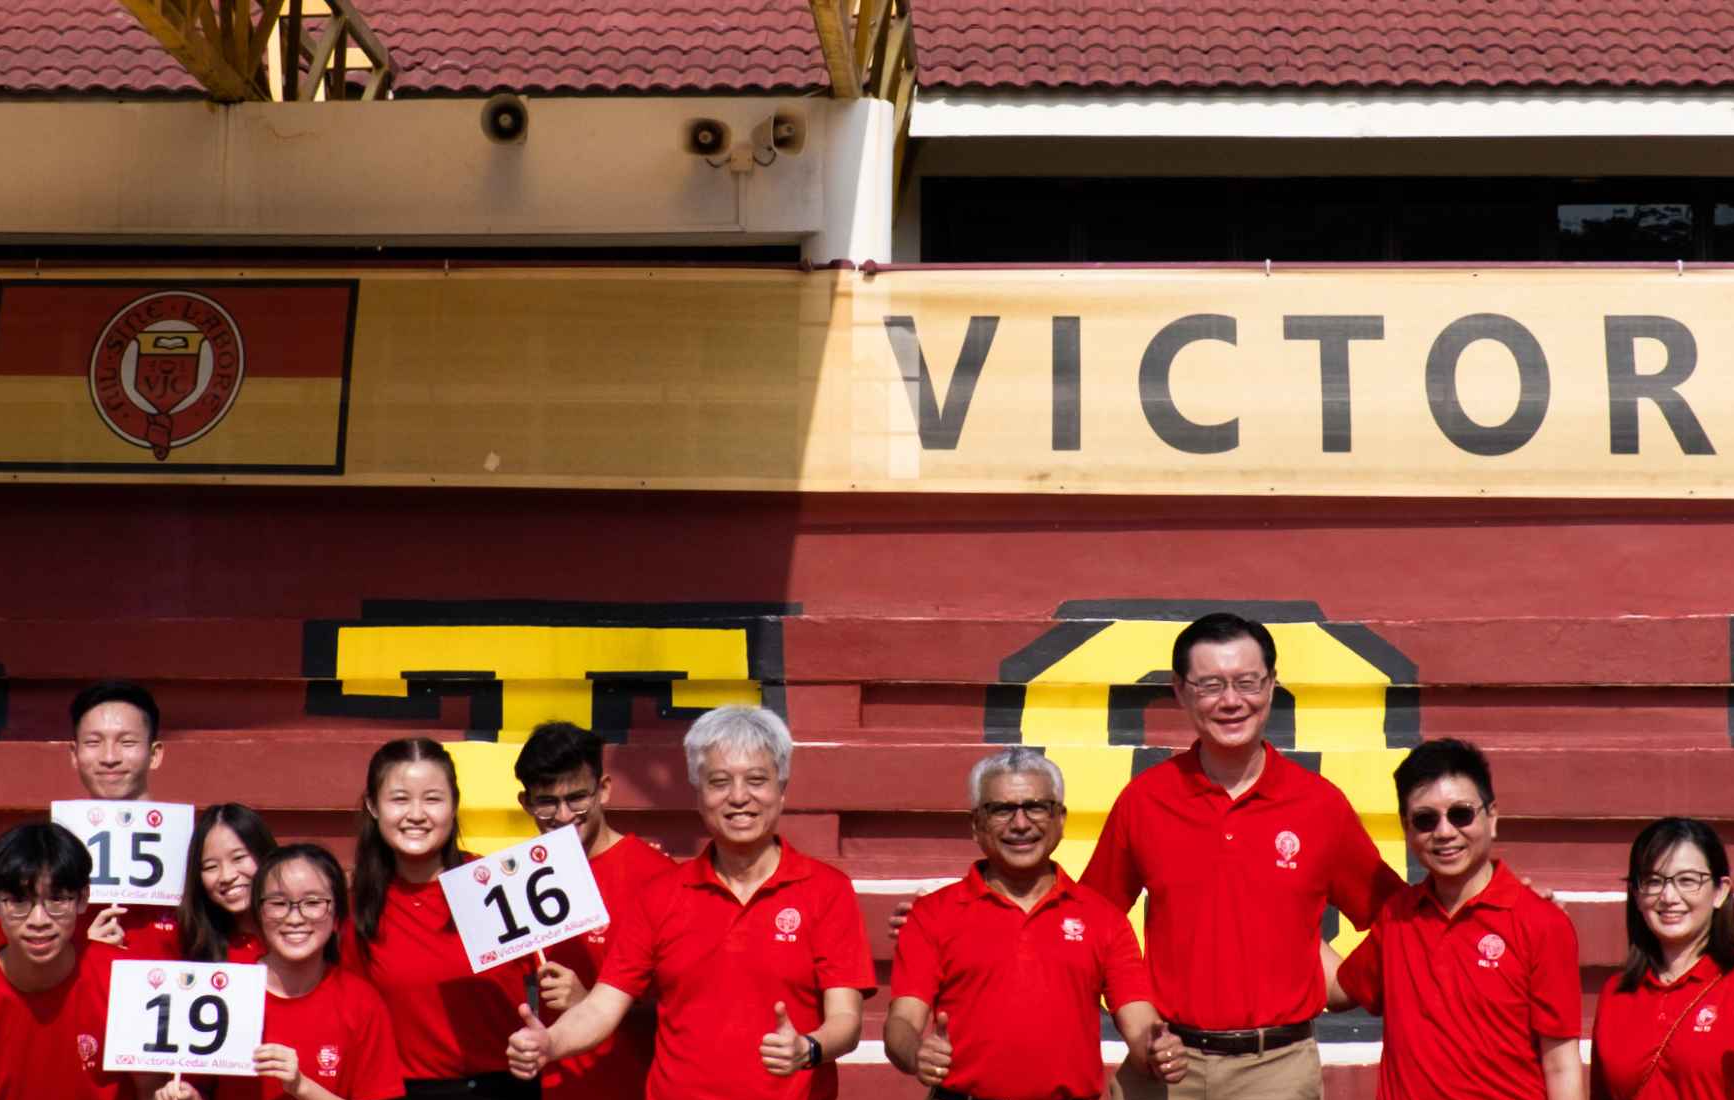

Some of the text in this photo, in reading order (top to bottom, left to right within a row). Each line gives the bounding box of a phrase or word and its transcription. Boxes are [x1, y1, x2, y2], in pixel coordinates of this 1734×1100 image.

[87, 830, 164, 888] 15
[484, 866, 570, 945] 16
[143, 993, 229, 1055] 19
